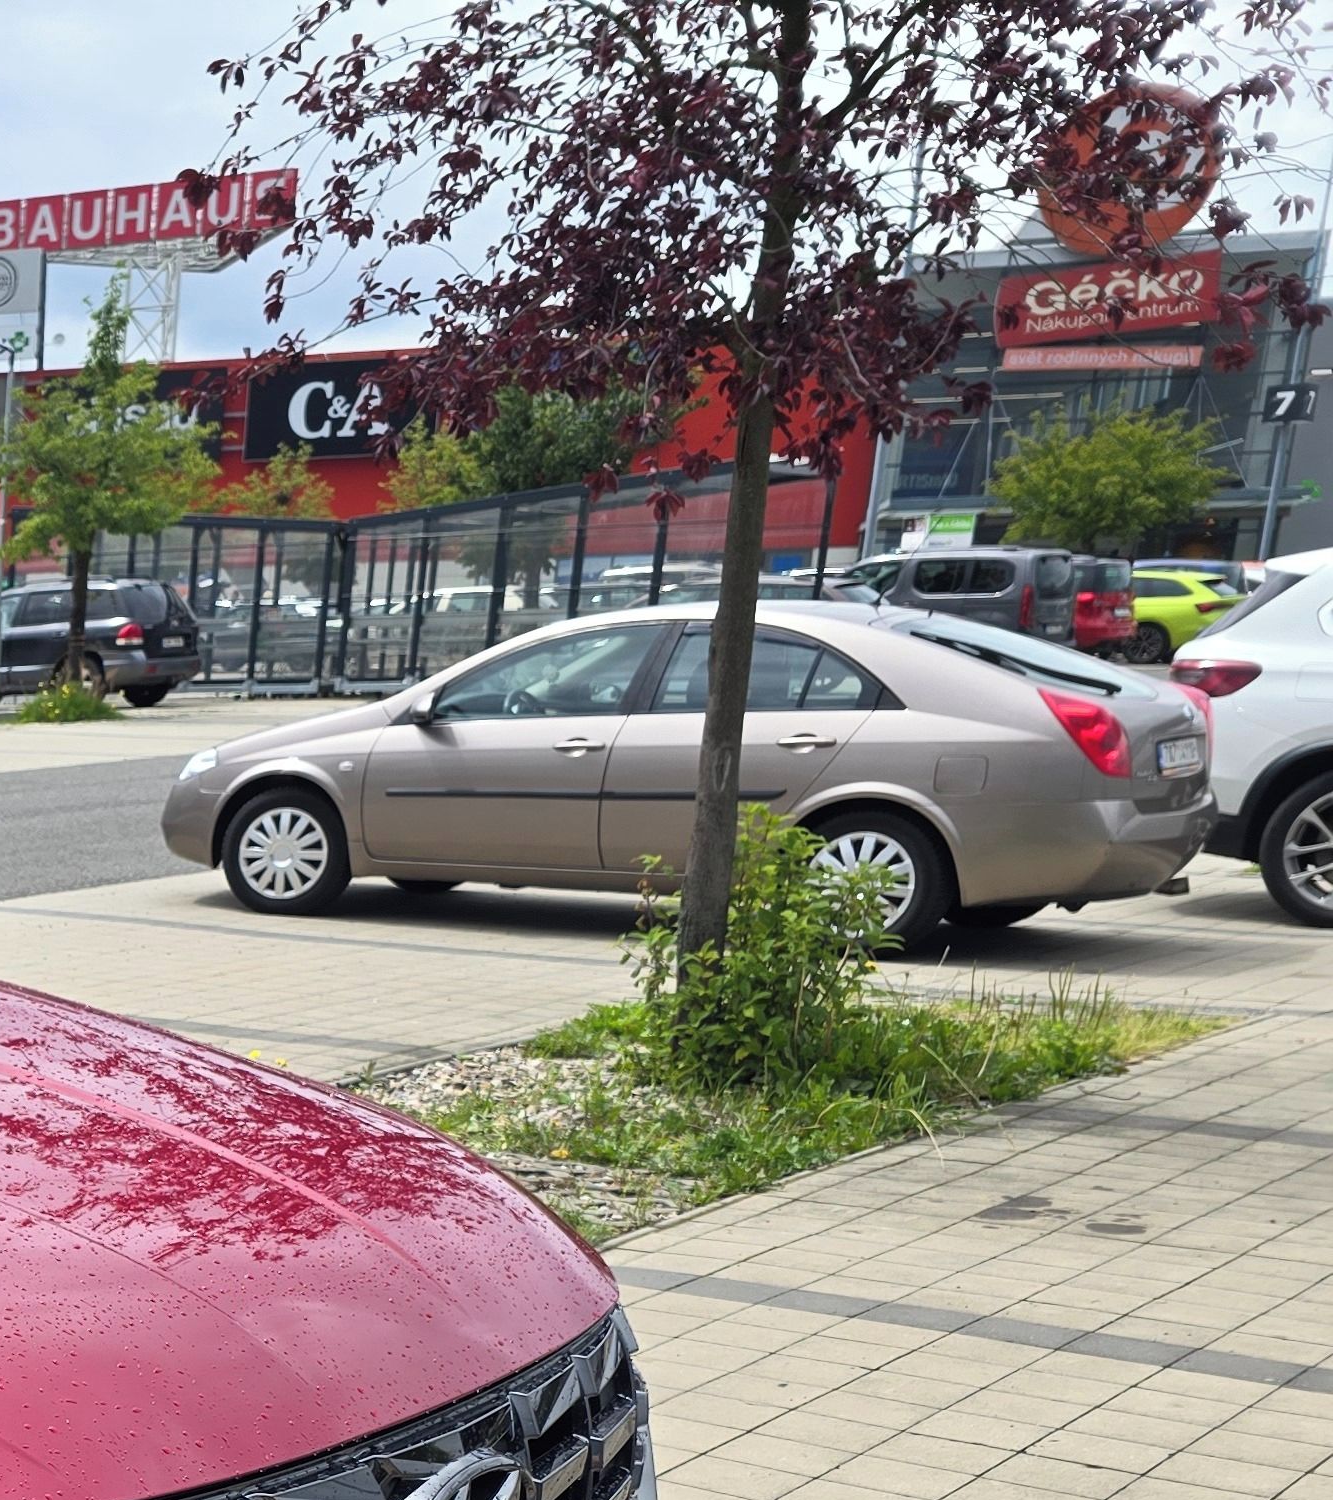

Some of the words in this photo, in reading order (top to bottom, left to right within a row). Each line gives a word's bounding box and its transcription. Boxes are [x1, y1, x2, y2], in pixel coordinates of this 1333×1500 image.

[1025, 268, 1204, 316] Géčko
[288, 381, 389, 439] C&A
[1276, 390, 1296, 416] 7
